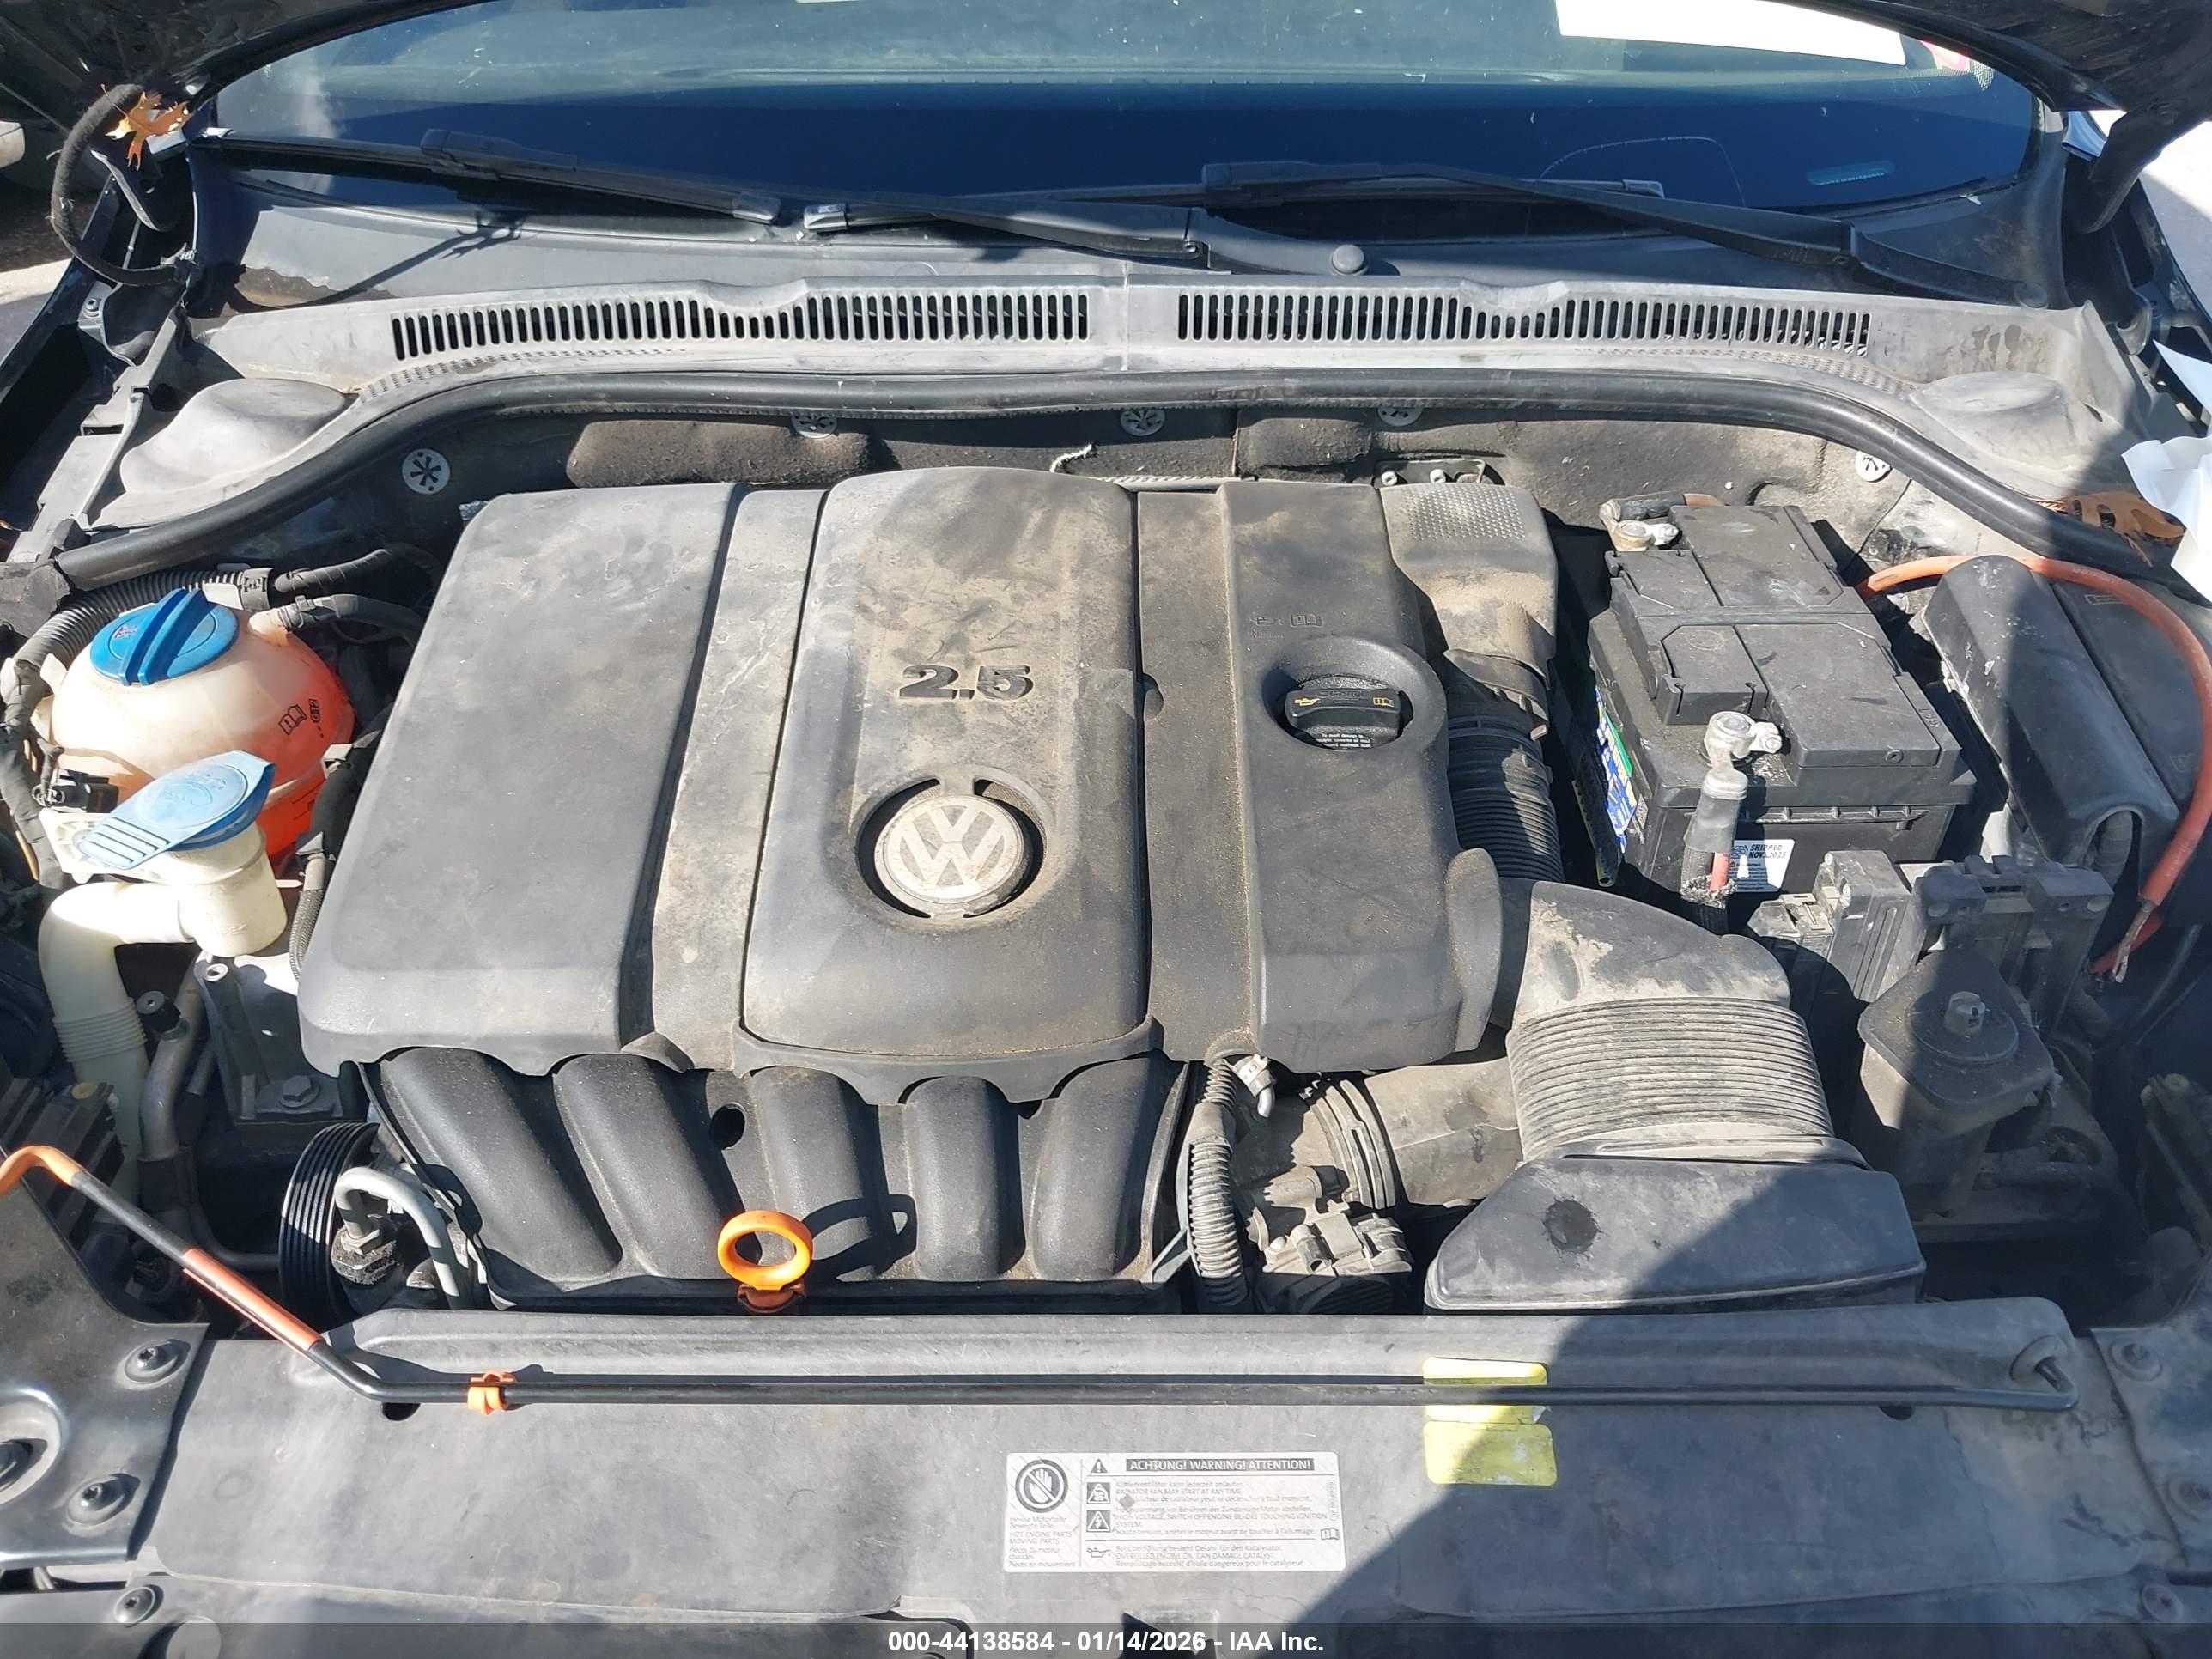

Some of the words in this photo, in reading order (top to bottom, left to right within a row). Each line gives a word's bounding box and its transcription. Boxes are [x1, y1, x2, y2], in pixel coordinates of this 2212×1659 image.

[899, 665, 1033, 700] 2.5
[1131, 1461, 1187, 1470] ACHTUNG!
[1190, 1461, 1245, 1470] WARNING!
[1249, 1460, 1310, 1469] ATTENTION!
